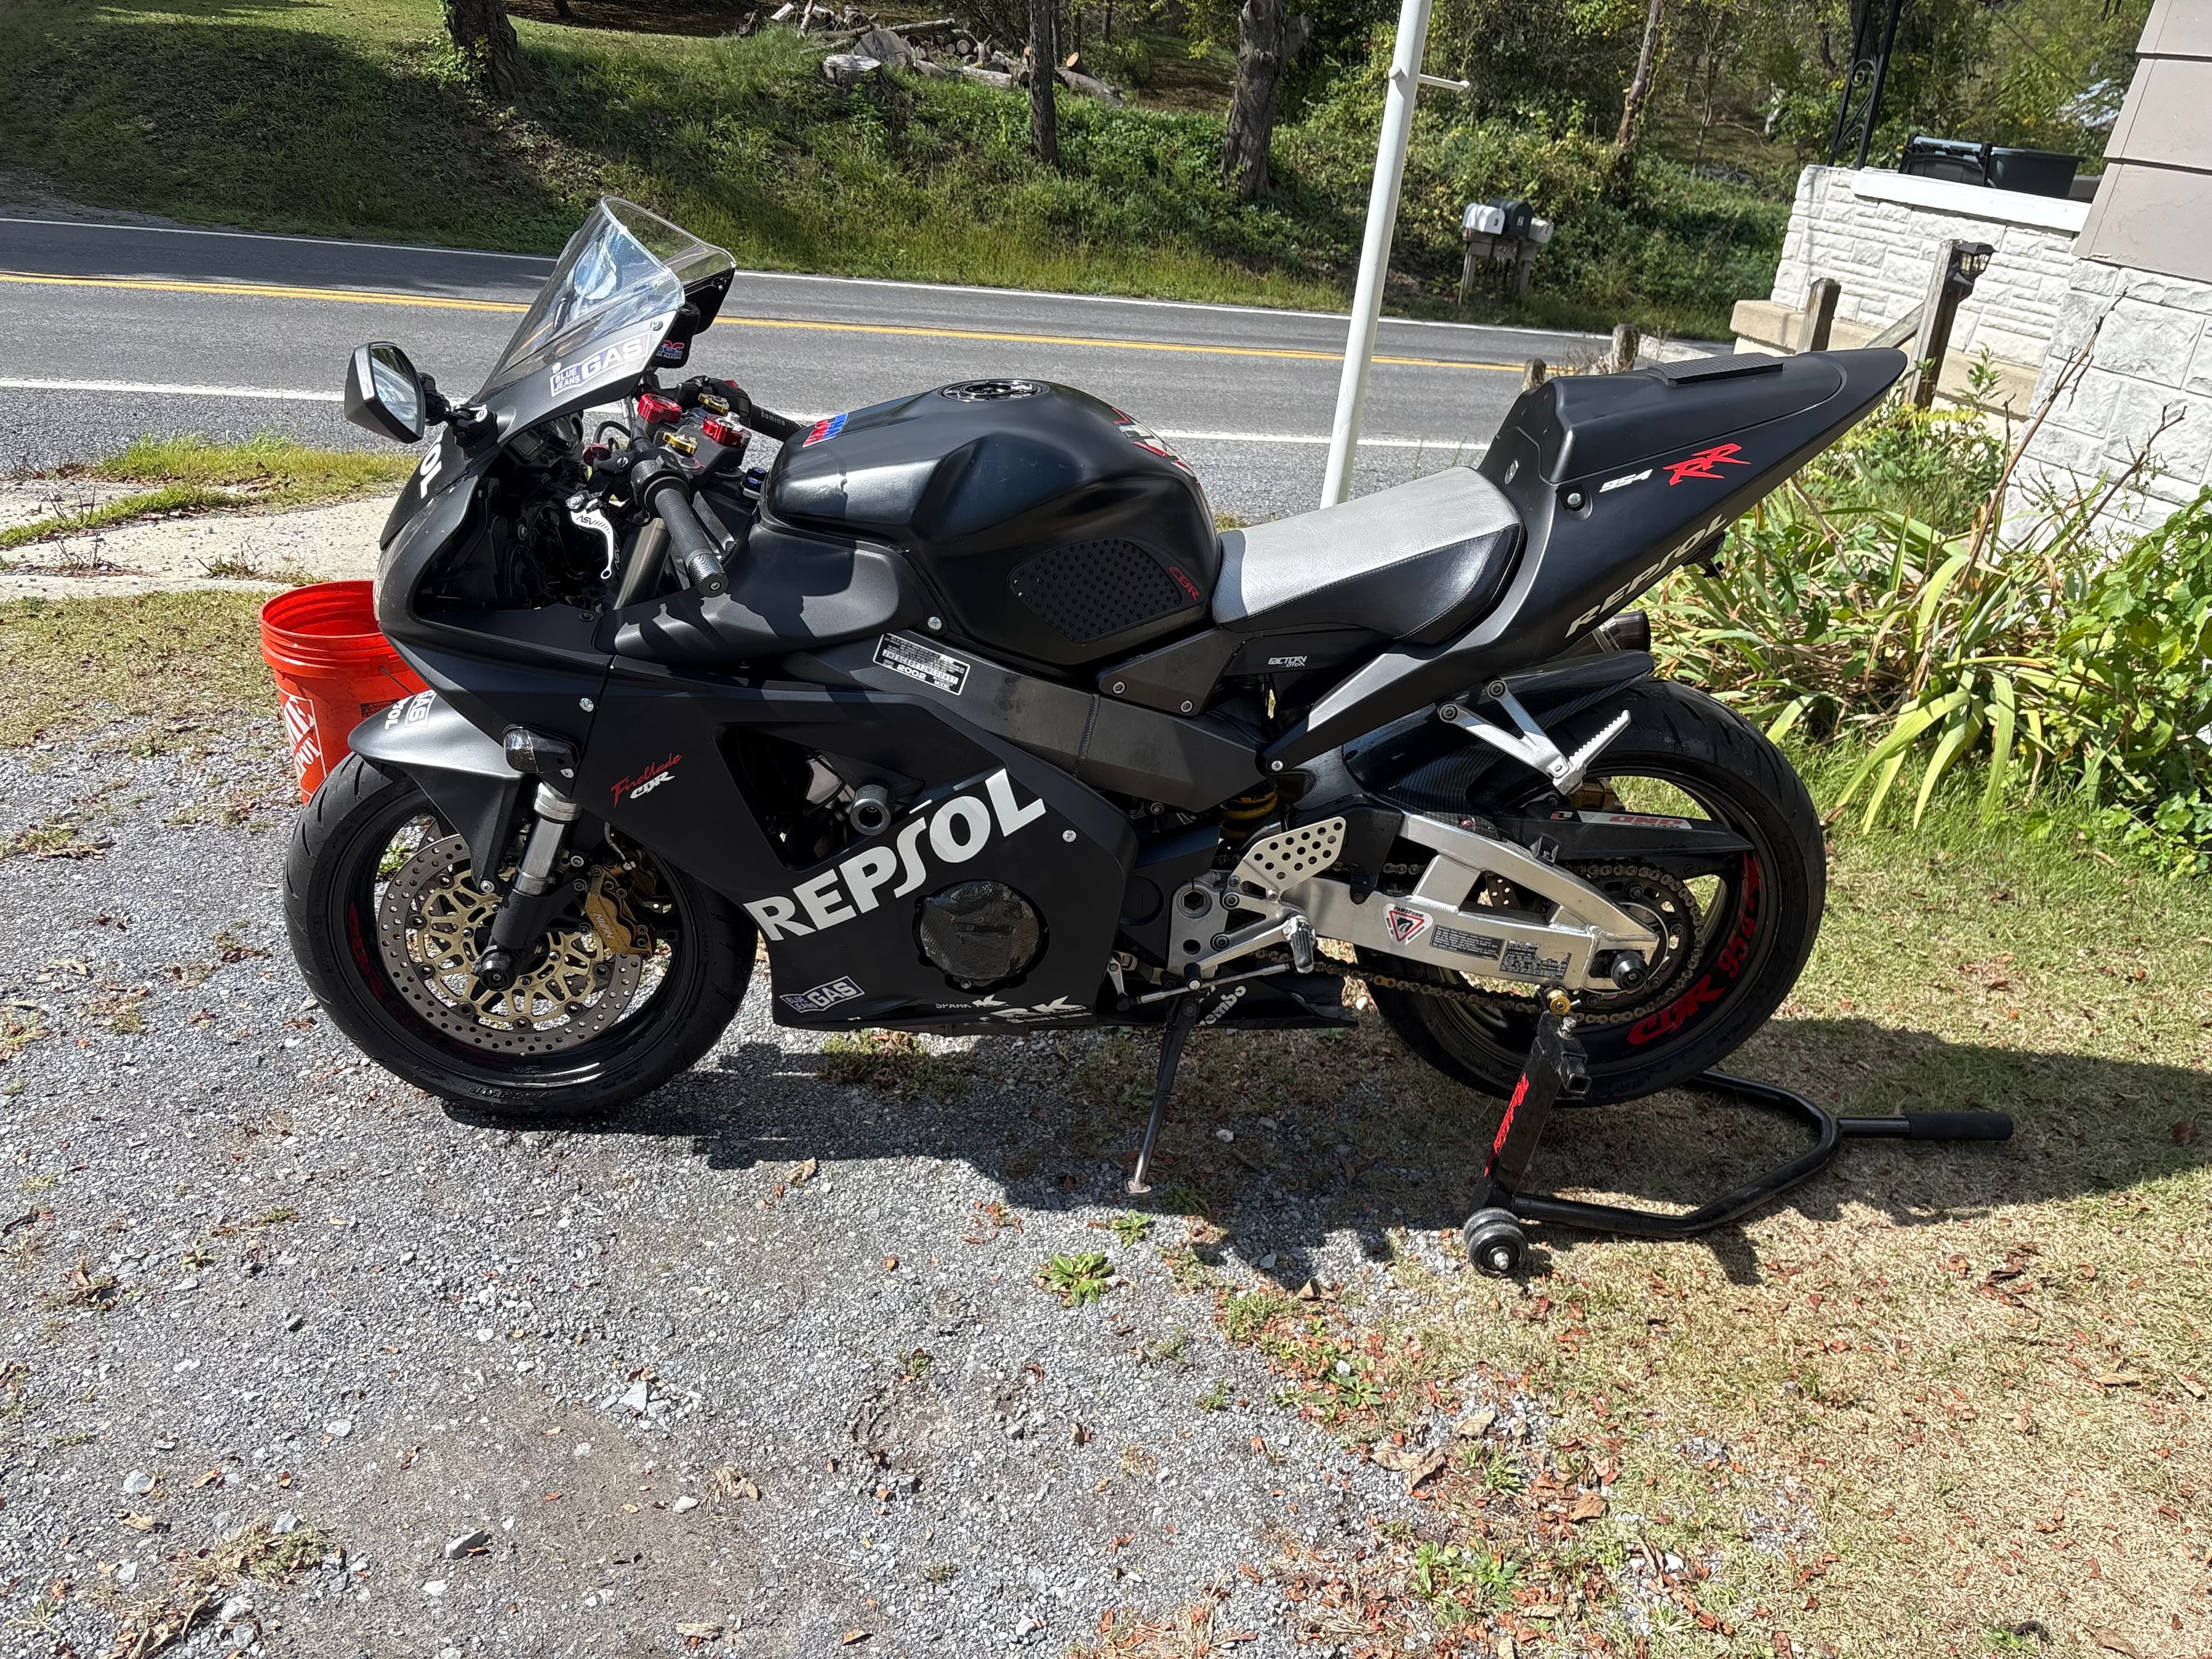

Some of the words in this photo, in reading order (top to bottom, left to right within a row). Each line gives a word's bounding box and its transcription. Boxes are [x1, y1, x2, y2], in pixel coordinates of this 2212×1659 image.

[581, 338, 642, 380] GAS
[554, 375, 580, 392] JEANS
[555, 367, 577, 383] BLUE
[1599, 469, 1653, 493] 954
[1662, 443, 1752, 486] RR
[576, 515, 597, 525] ASV
[1168, 567, 1200, 601] CBR
[1565, 513, 1727, 639] REPSOL
[896, 664, 926, 680] 2002
[1268, 656, 1308, 666] FACTORY
[630, 771, 676, 798] CBR
[743, 768, 1046, 941] REPSOL
[594, 913, 615, 939] NISSIN
[785, 996, 807, 1004] BLUE
[794, 1002, 819, 1010] JEANS
[807, 982, 857, 1007] GAS
[1627, 975, 1726, 1046] CBR
